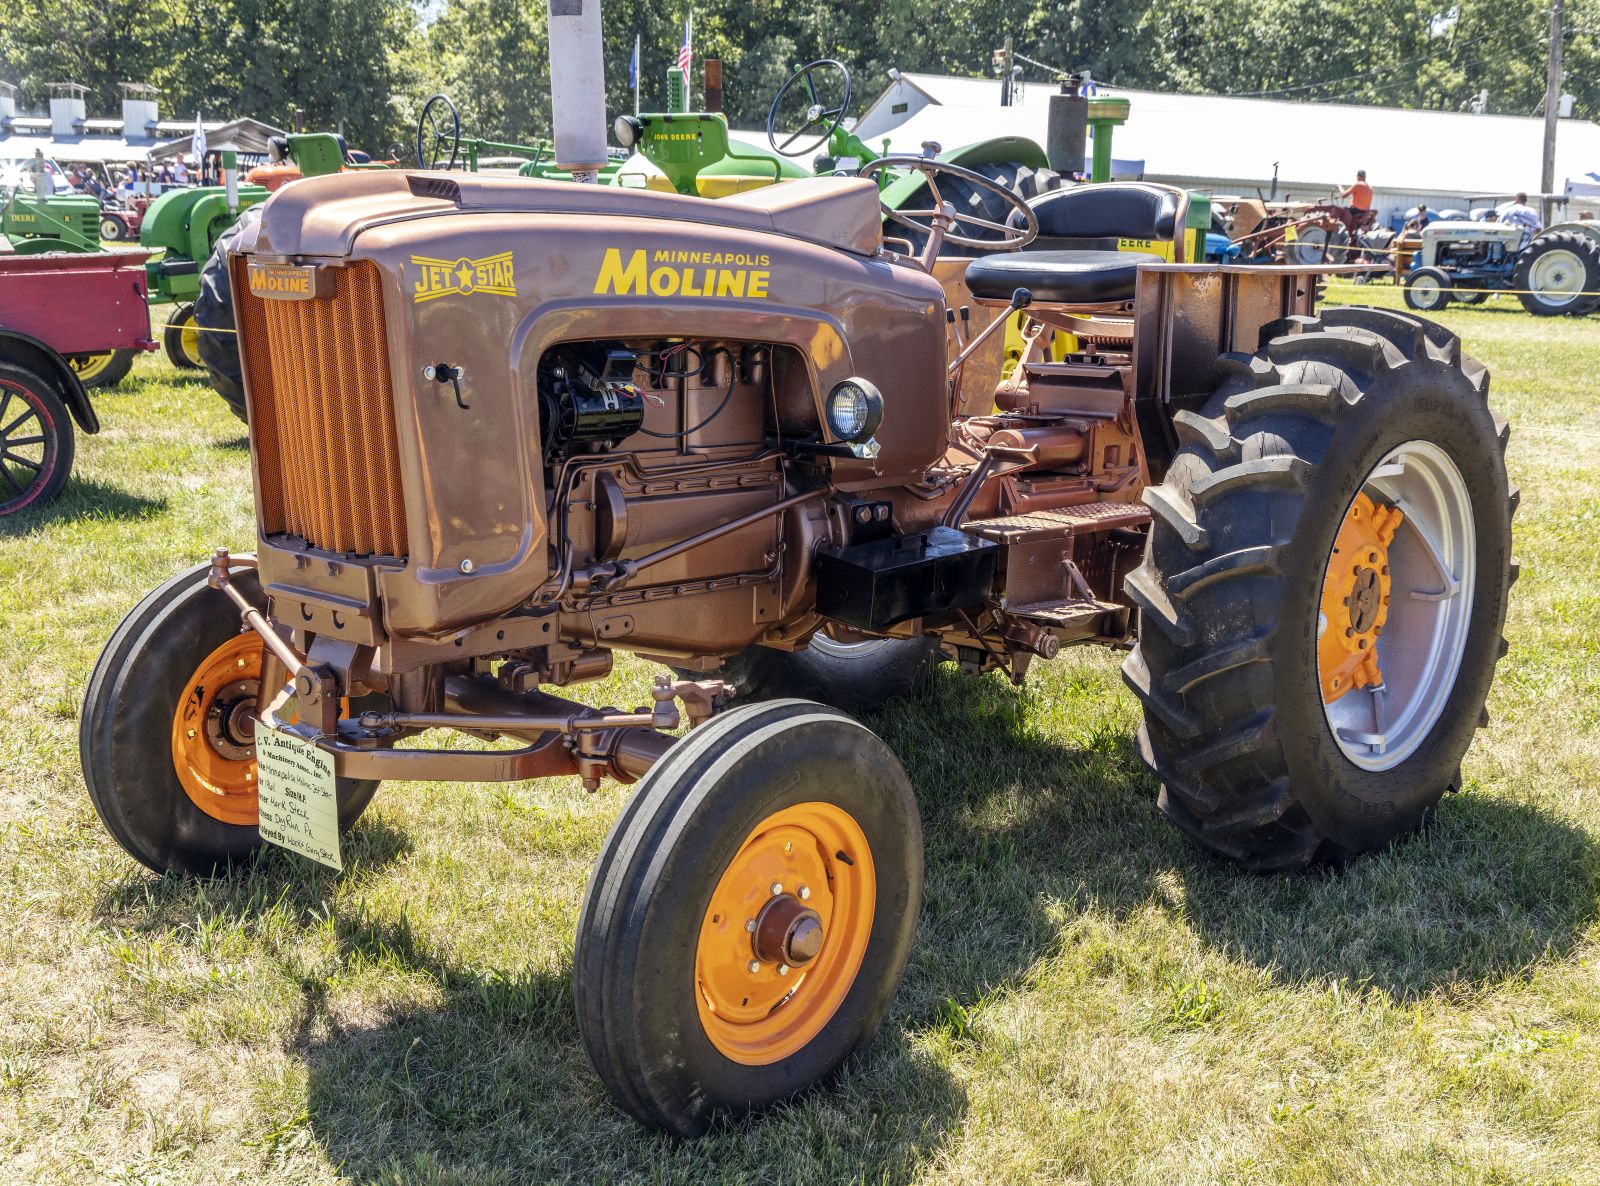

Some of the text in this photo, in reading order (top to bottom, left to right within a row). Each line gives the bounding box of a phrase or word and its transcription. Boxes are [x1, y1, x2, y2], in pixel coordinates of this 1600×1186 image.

[653, 133, 697, 141] JOHN DEERE
[1120, 238, 1152, 248] EERE
[654, 250, 770, 266] MINNEAPOLIS
[251, 268, 310, 293] MOLINE
[414, 260, 516, 293] JET STAR
[592, 247, 771, 298] MOLINE
[267, 751, 296, 769] Machinery
[273, 737, 305, 756] Antique
[305, 748, 331, 778] Engine
